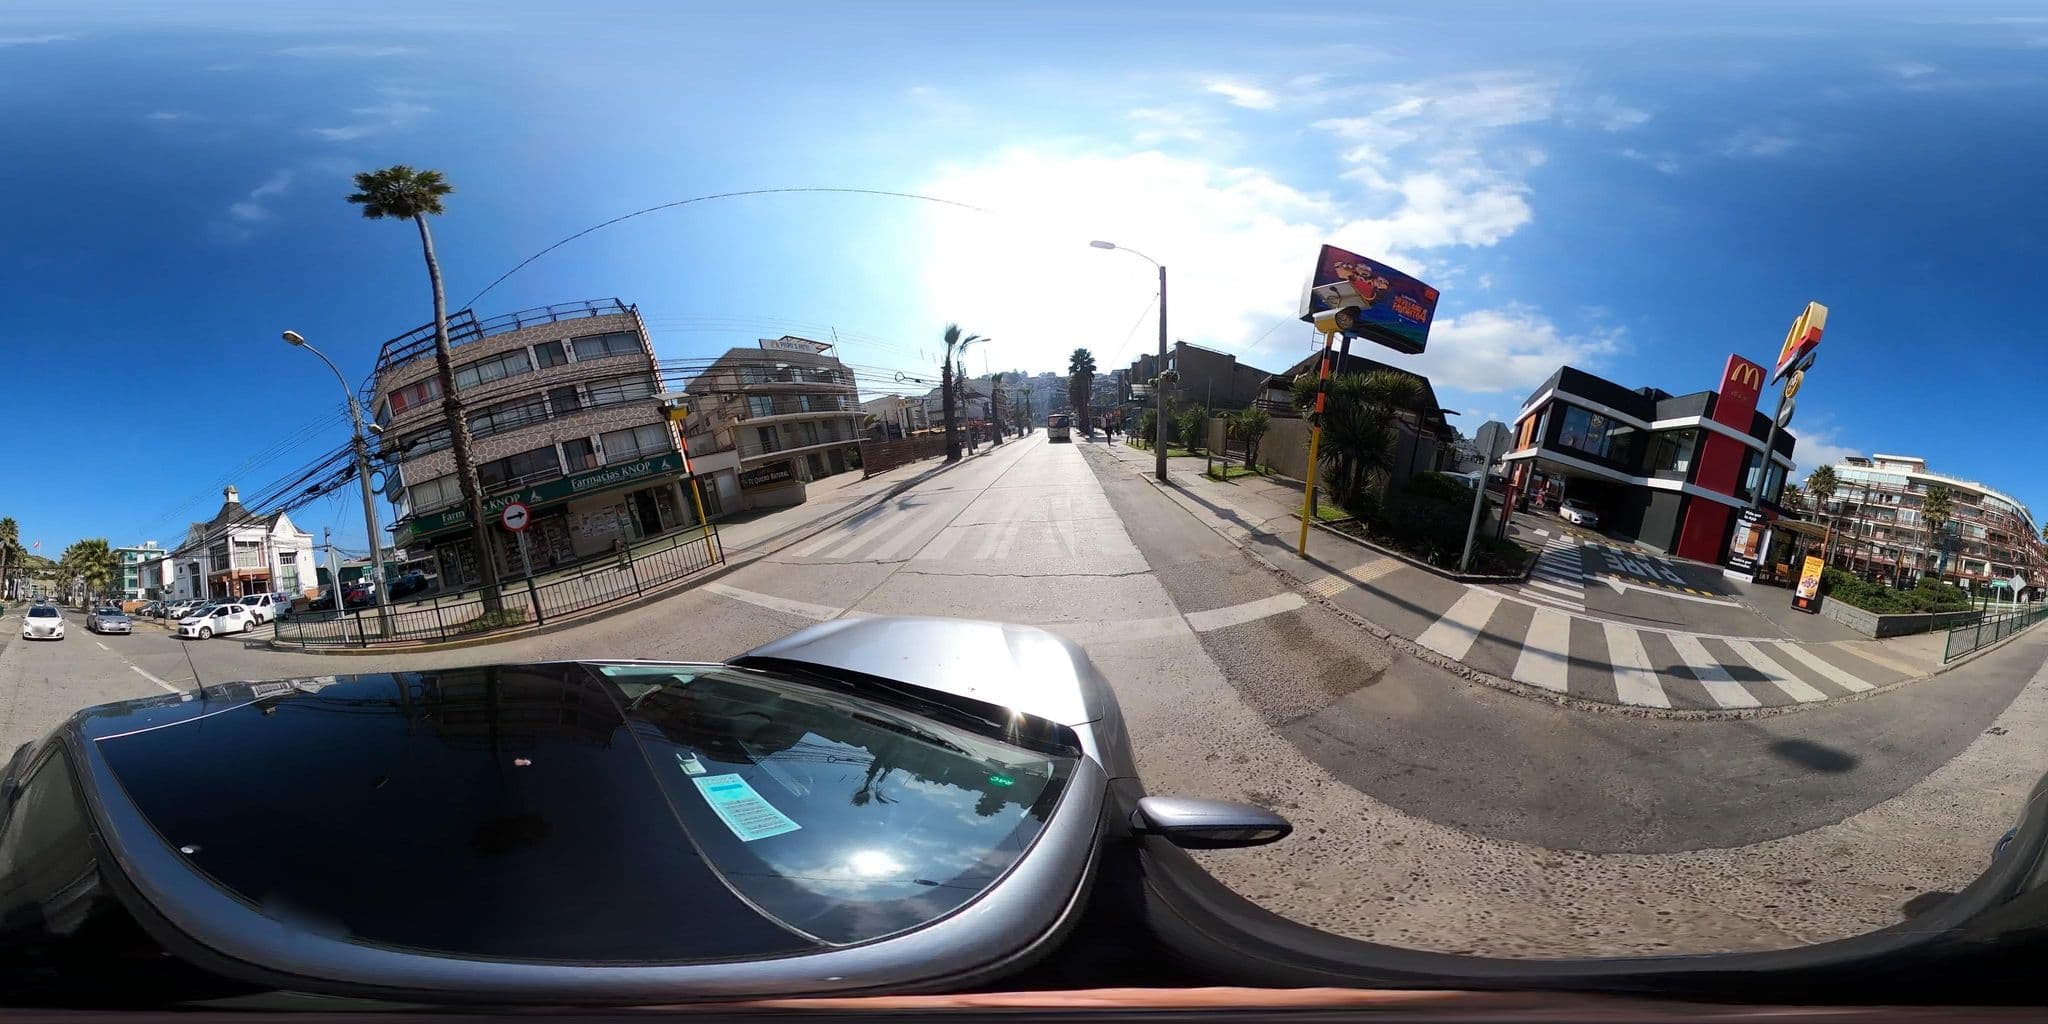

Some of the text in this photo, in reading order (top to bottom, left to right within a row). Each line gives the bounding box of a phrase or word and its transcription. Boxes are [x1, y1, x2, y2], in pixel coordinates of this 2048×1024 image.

[571, 470, 620, 489] Farmacias
[621, 461, 651, 476] KNOP
[489, 493, 520, 510] KNOP
[1600, 551, 1688, 586] PARE
